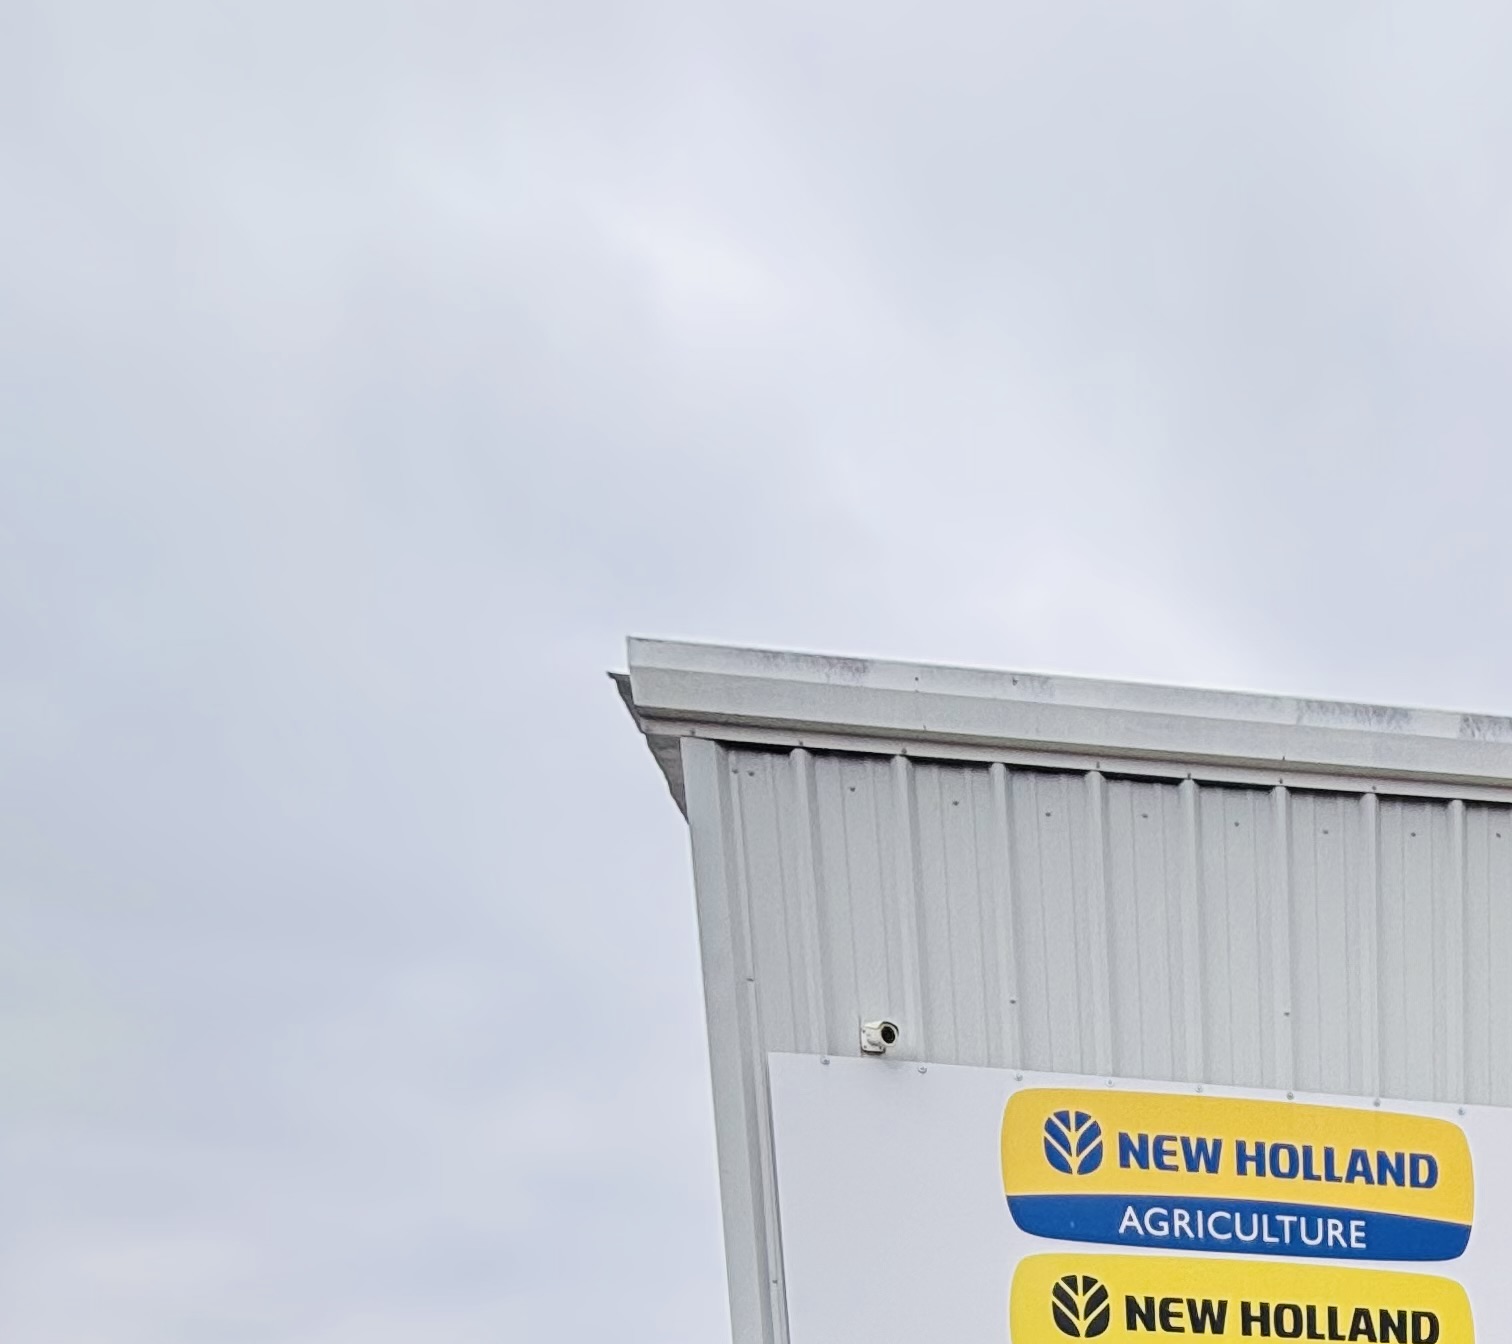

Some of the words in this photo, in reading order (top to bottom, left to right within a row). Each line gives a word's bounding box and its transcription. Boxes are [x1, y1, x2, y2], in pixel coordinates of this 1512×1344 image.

[1118, 1131, 1223, 1174] NEW
[1235, 1139, 1439, 1189] HOLLAND
[1118, 1205, 1367, 1249] AGRICULTURE
[1125, 1295, 1228, 1335] NEW
[1241, 1301, 1440, 1344] HOLLAND
